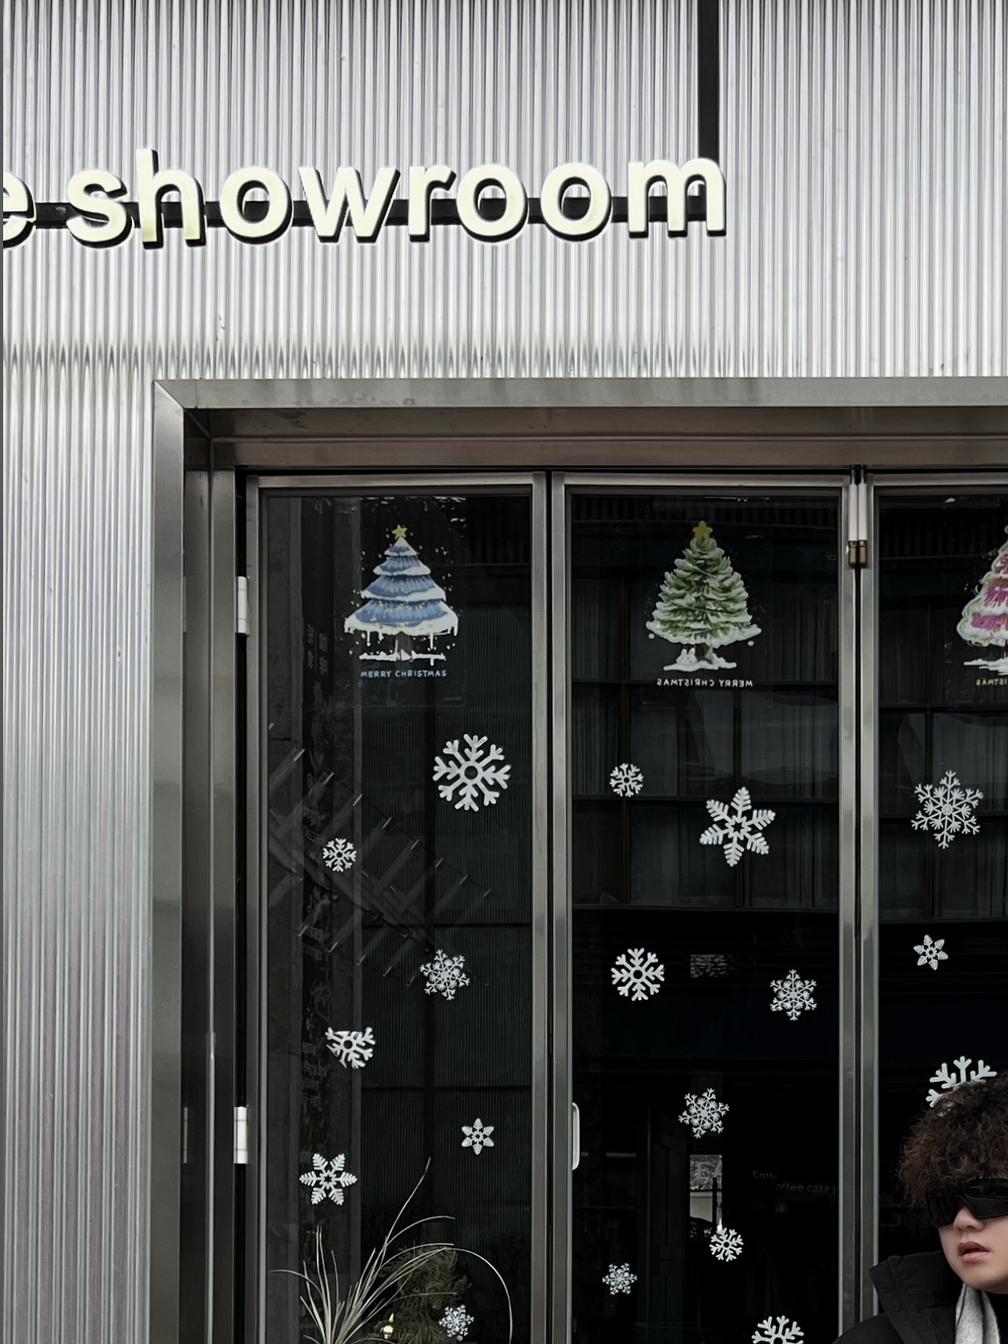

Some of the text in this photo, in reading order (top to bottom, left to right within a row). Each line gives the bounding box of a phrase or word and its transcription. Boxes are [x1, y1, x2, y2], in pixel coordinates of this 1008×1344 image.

[66, 148, 727, 249] showroom
[360, 668, 447, 678] MERRY CHRISTMAS
